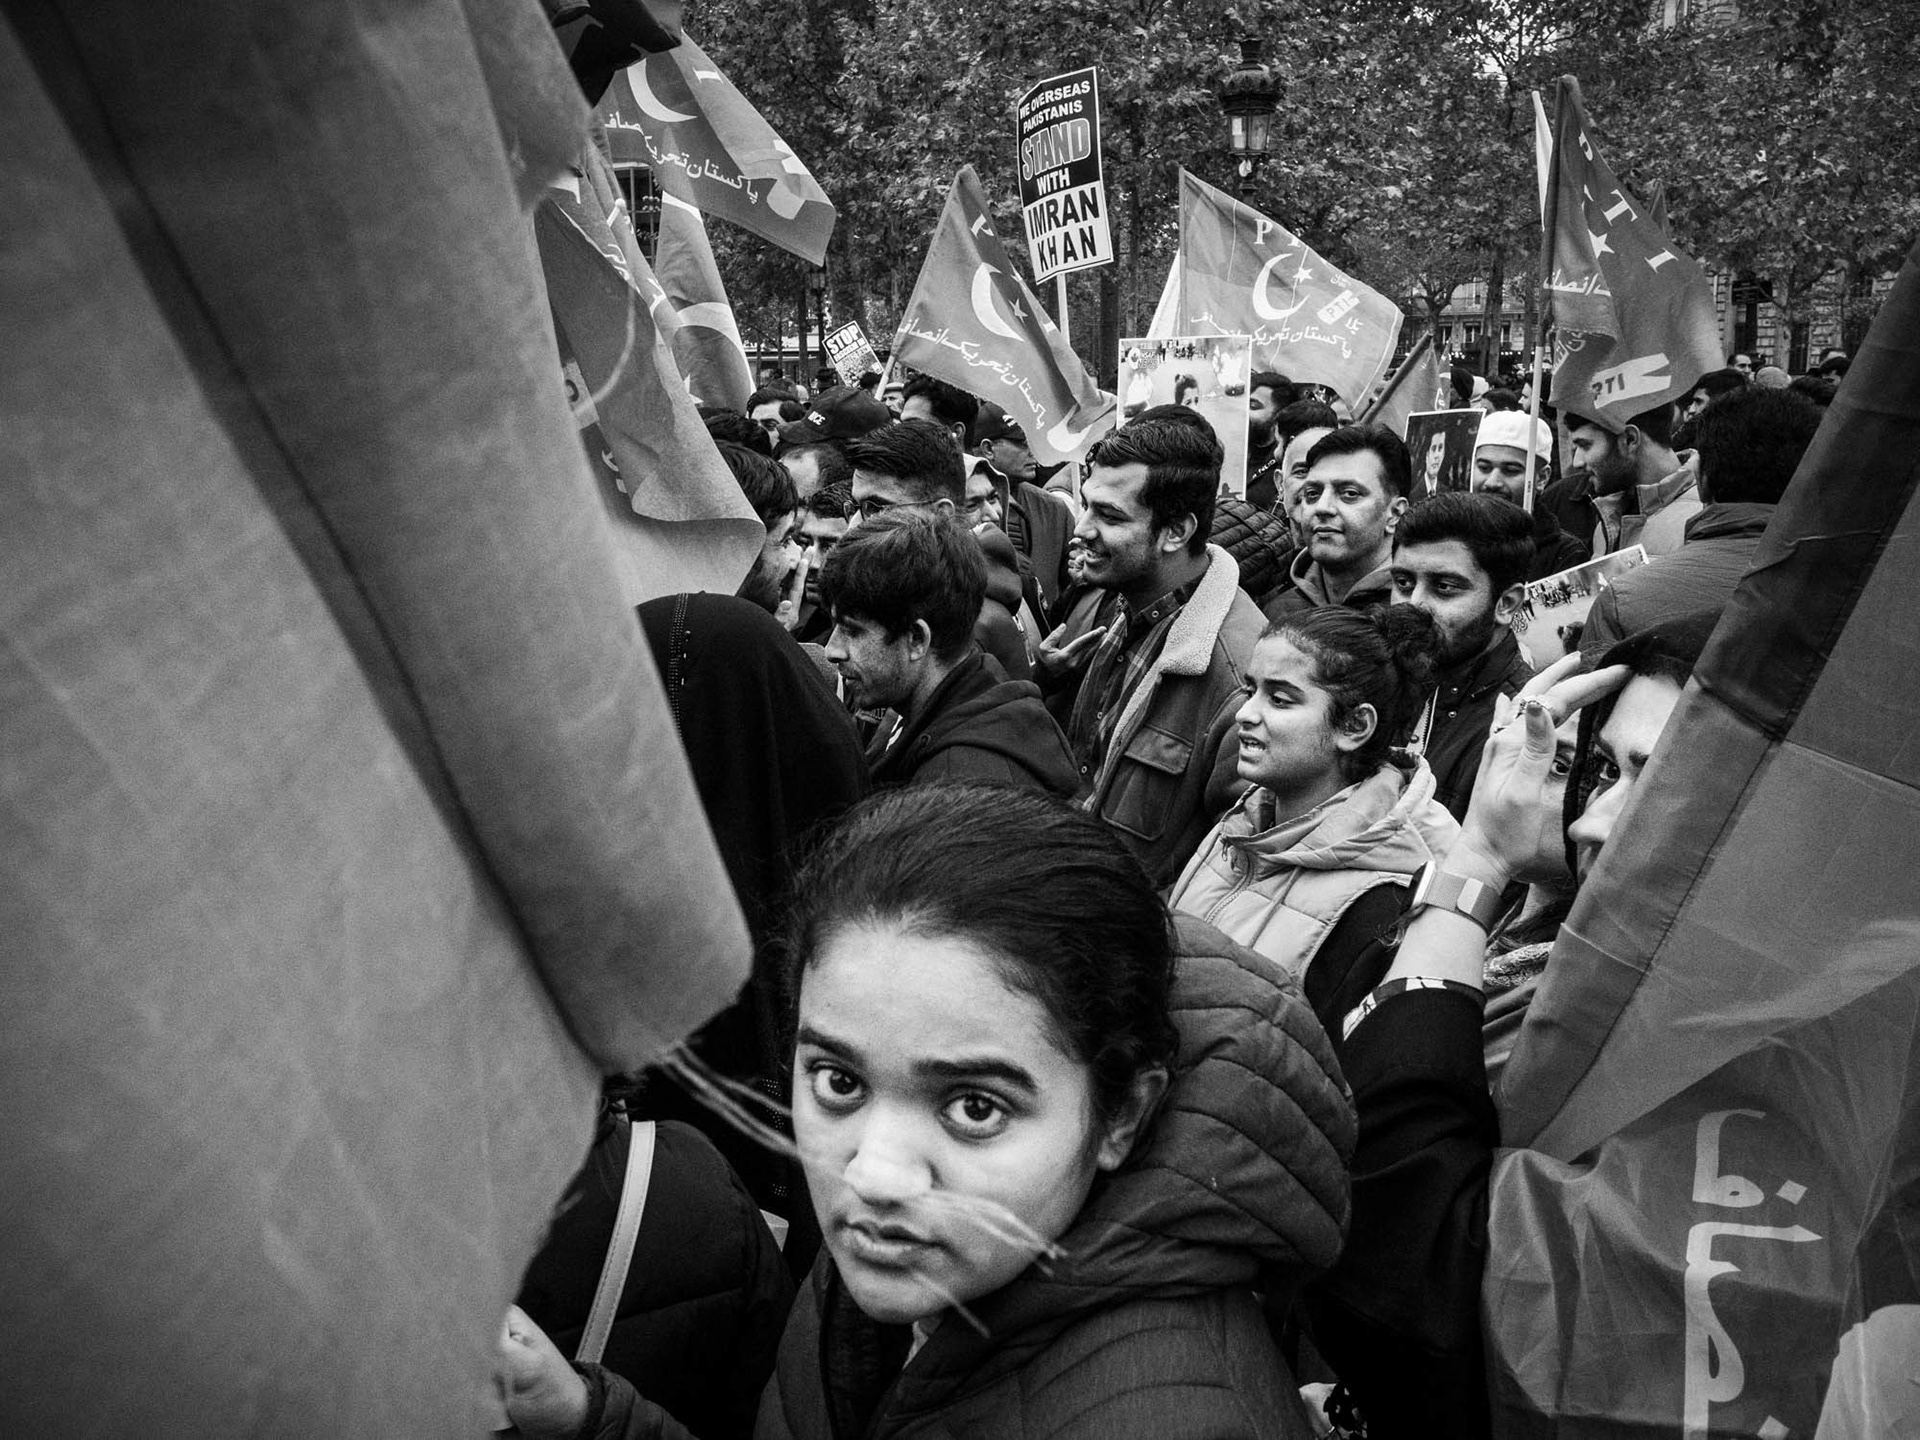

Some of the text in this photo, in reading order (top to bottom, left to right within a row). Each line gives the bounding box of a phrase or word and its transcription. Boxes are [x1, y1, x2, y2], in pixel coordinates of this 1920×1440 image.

[1020, 80, 1091, 120] WE OVERSEAS
[1023, 100, 1083, 133] PAKISTANIS
[1021, 118, 1091, 180] STAND
[1037, 167, 1071, 196] WITH
[1028, 186, 1100, 240] IMRAN
[1037, 225, 1098, 273] KHAN
[1326, 298, 1350, 317] PTI
[826, 325, 859, 354] STOP
[1684, 1107, 1825, 1440] نصاف
